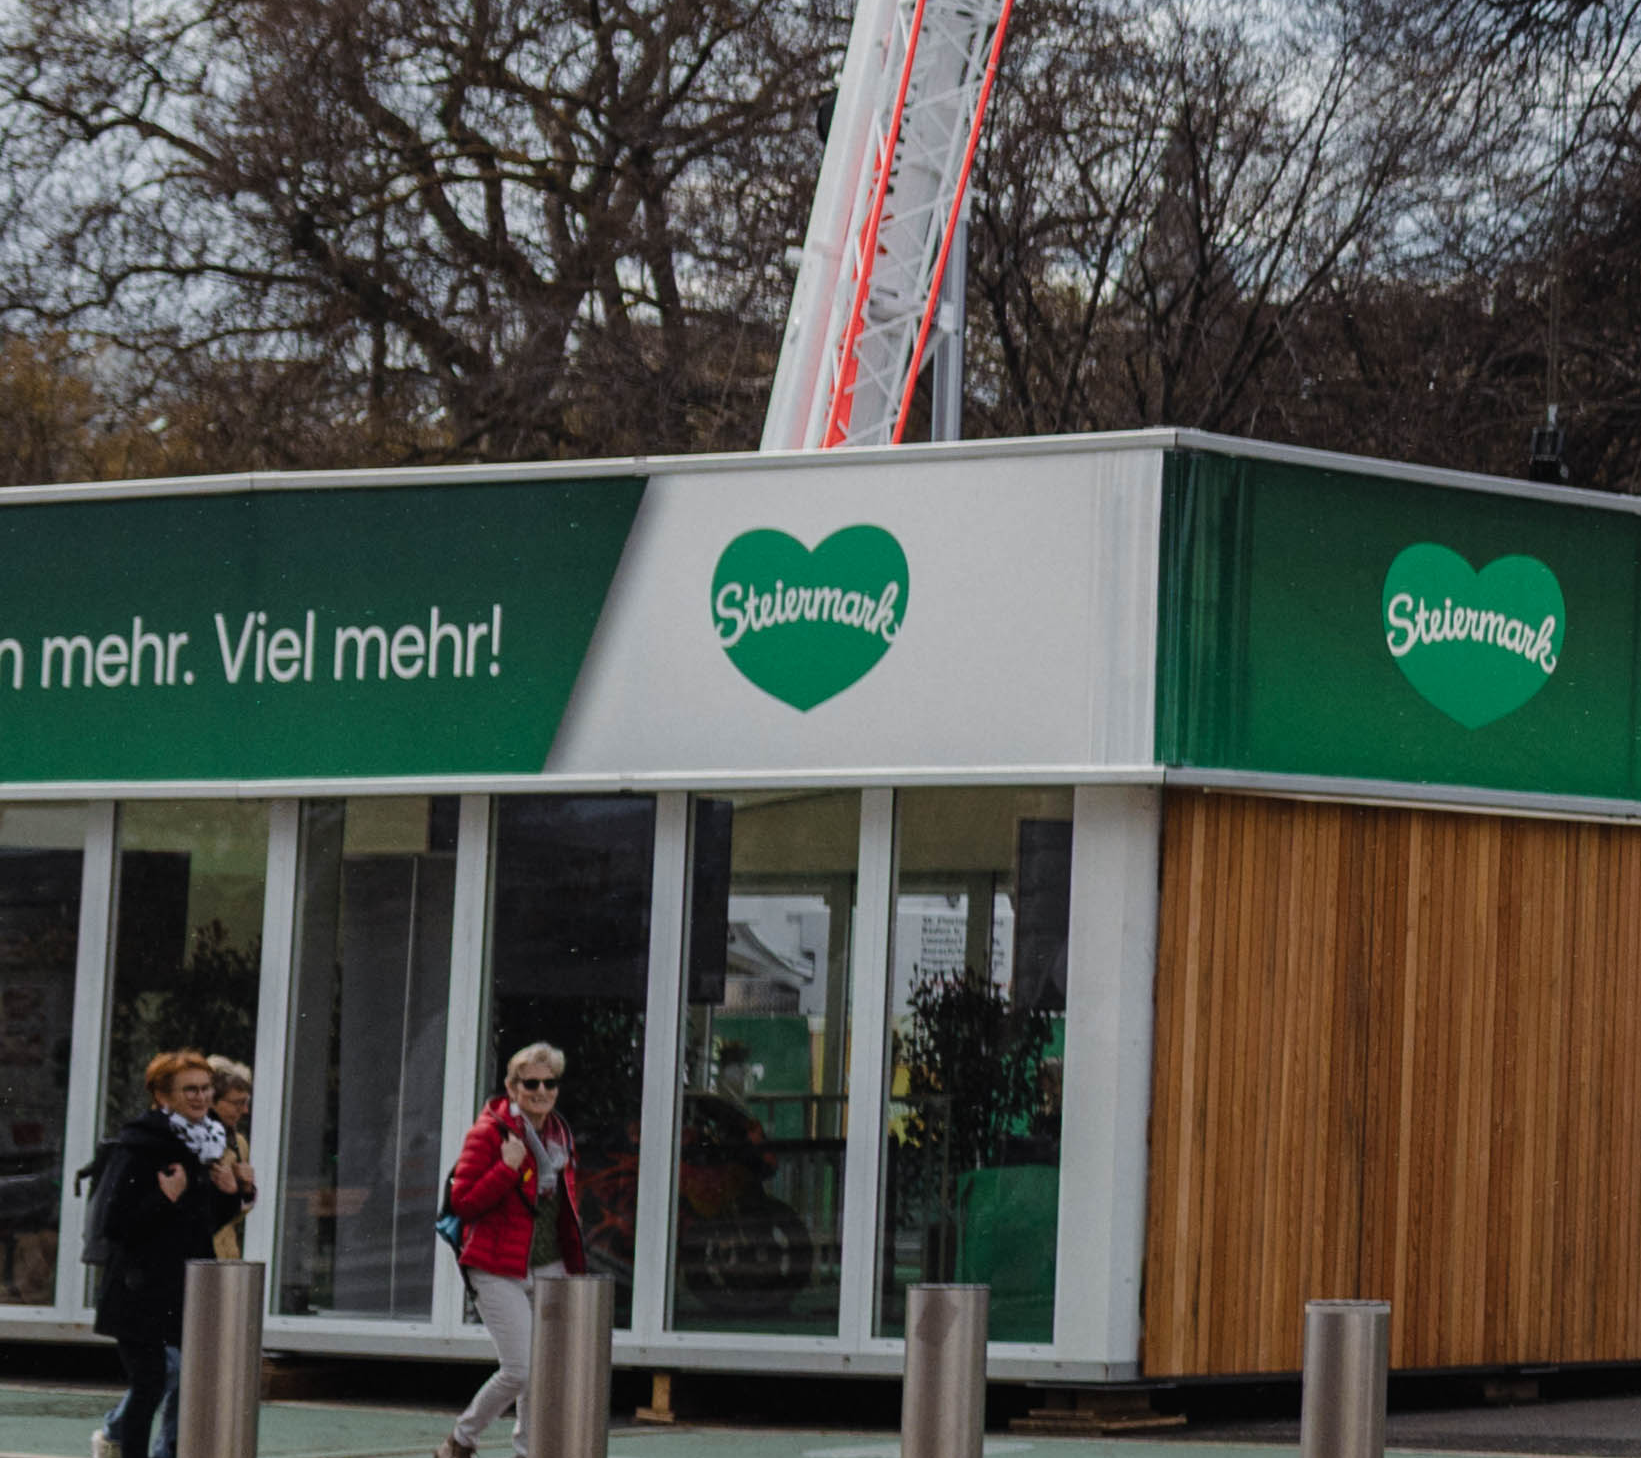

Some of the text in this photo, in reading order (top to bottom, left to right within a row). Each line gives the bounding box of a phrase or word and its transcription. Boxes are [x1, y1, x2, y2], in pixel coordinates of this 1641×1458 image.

[40, 615, 195, 689] mehr.
[213, 609, 316, 684] Viel
[332, 603, 502, 681] mehr!
[713, 579, 902, 647] Steiermark
[1385, 592, 1557, 675] Steiermark
